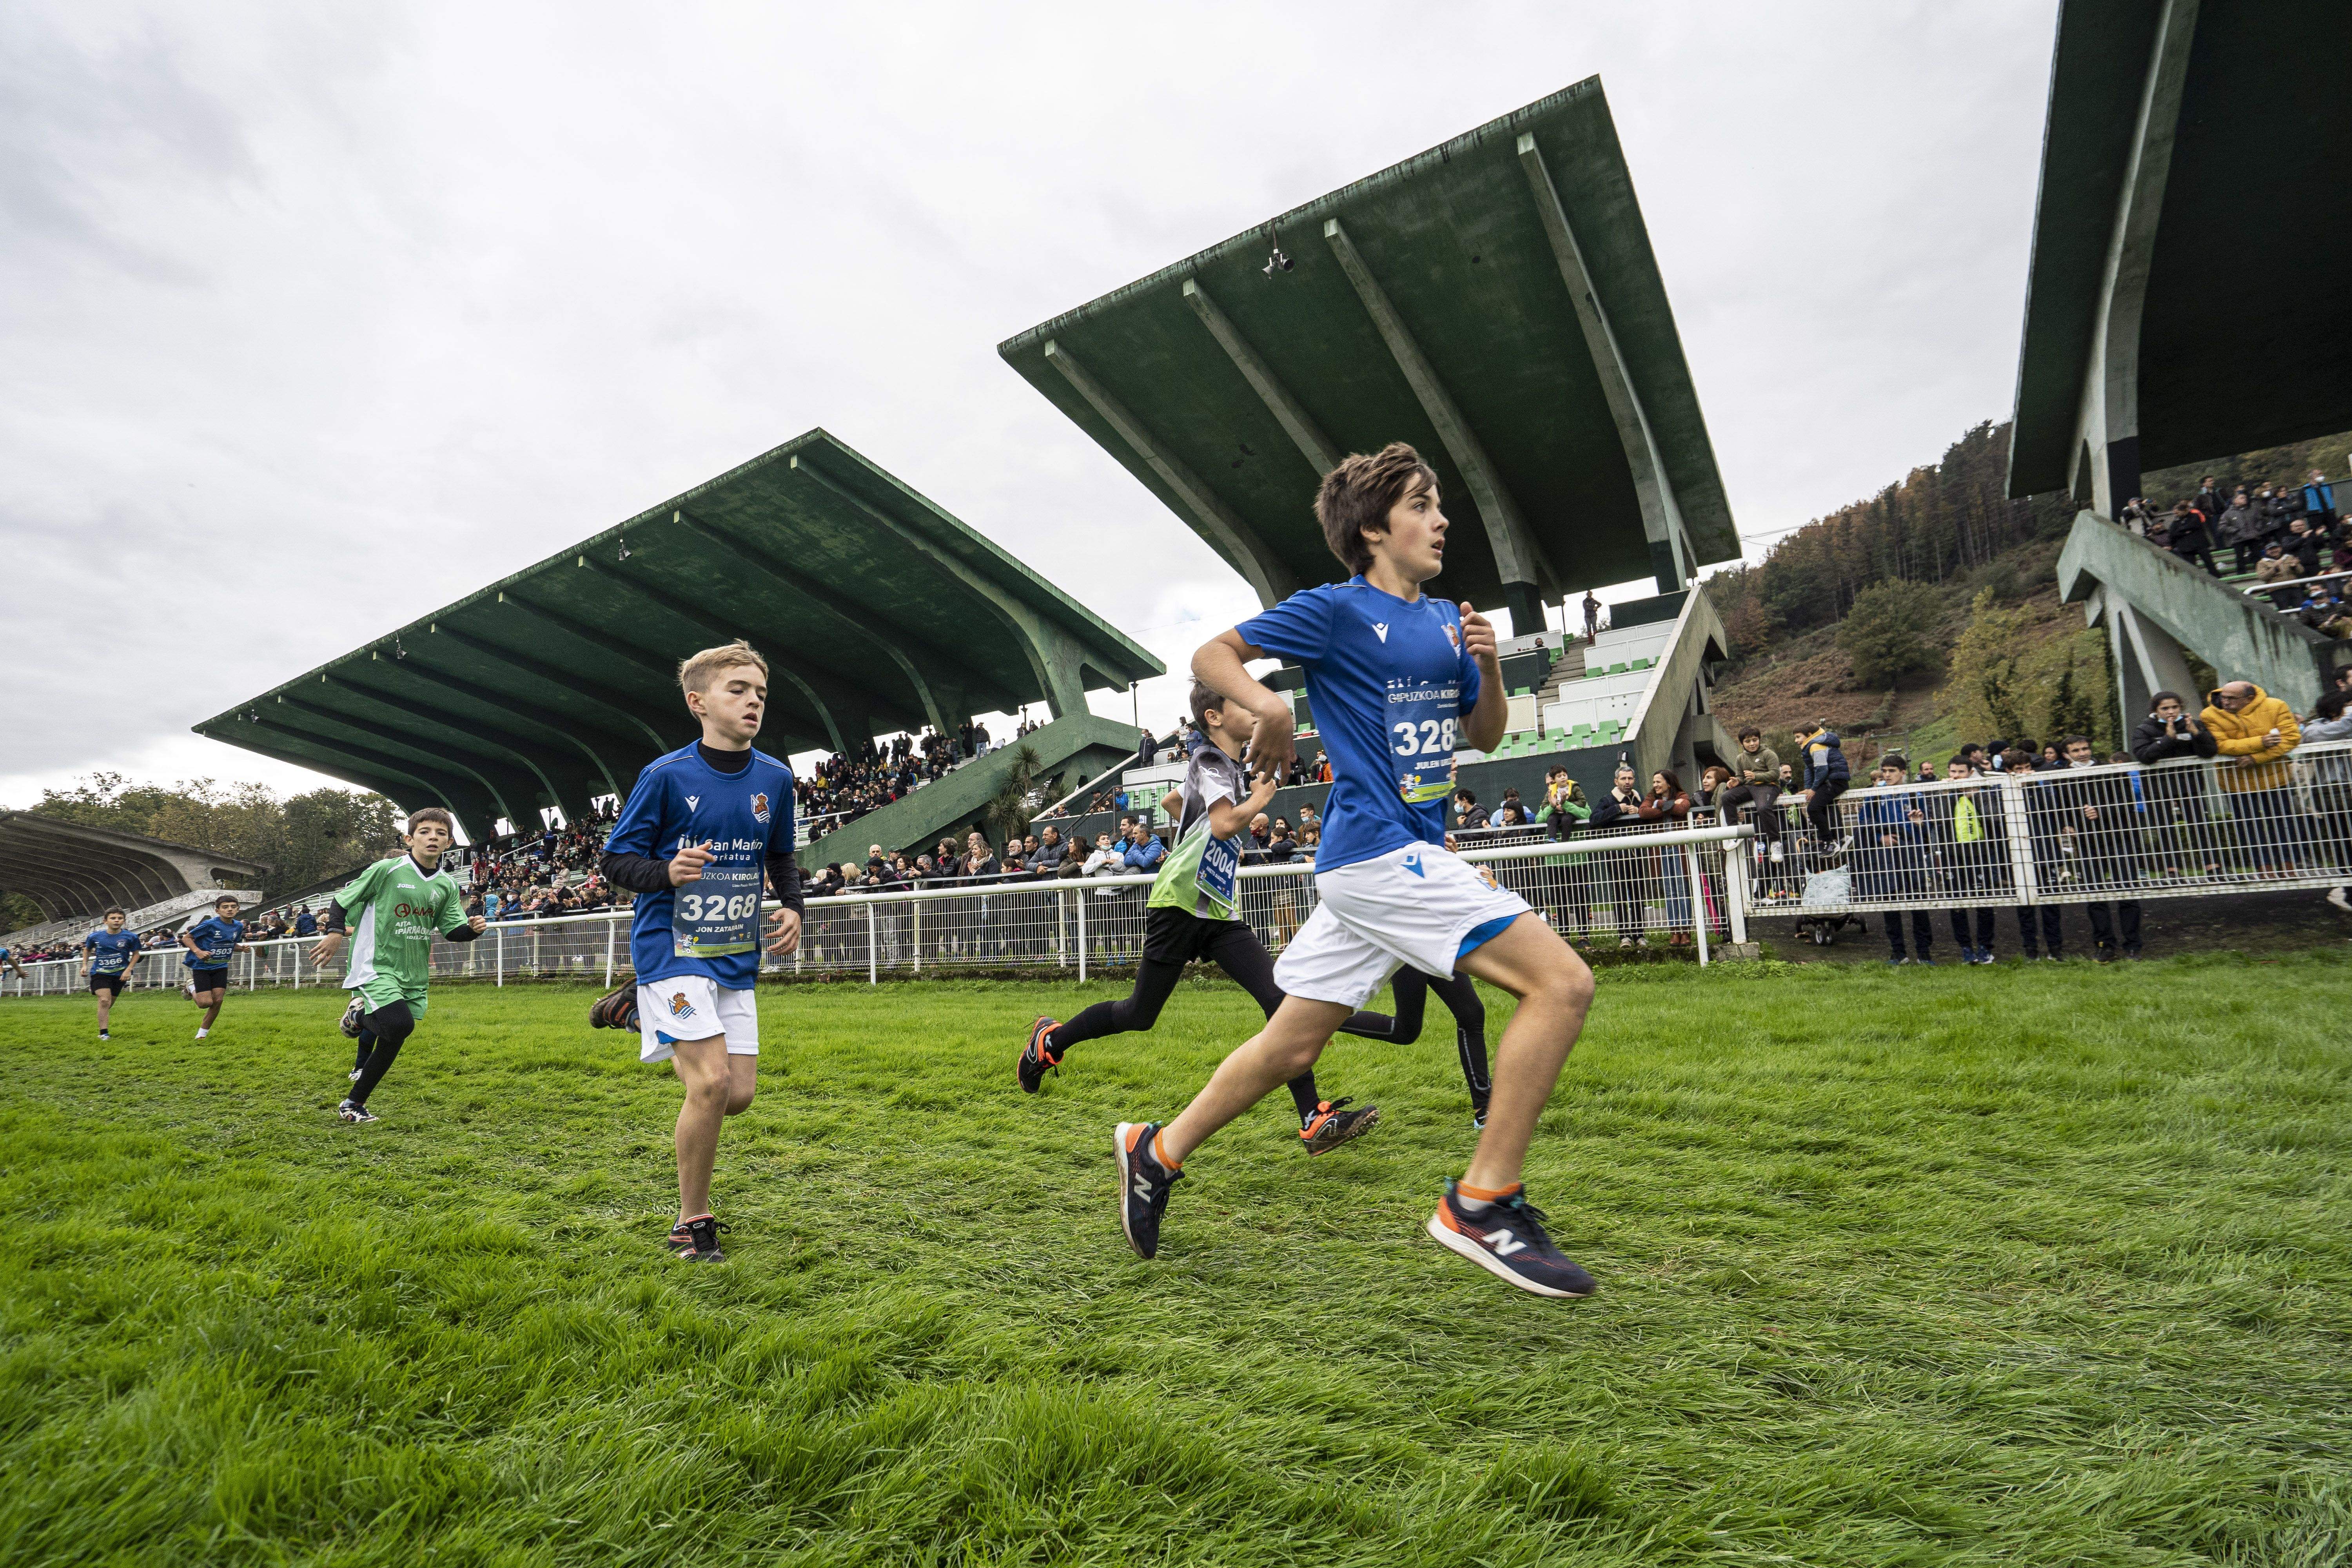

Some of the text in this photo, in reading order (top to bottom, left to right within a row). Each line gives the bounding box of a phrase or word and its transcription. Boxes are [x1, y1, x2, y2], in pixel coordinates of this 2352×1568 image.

[1204, 840, 1234, 879] 2004
[681, 894, 757, 921] 3268
[714, 924, 744, 933] ZATARAIN
